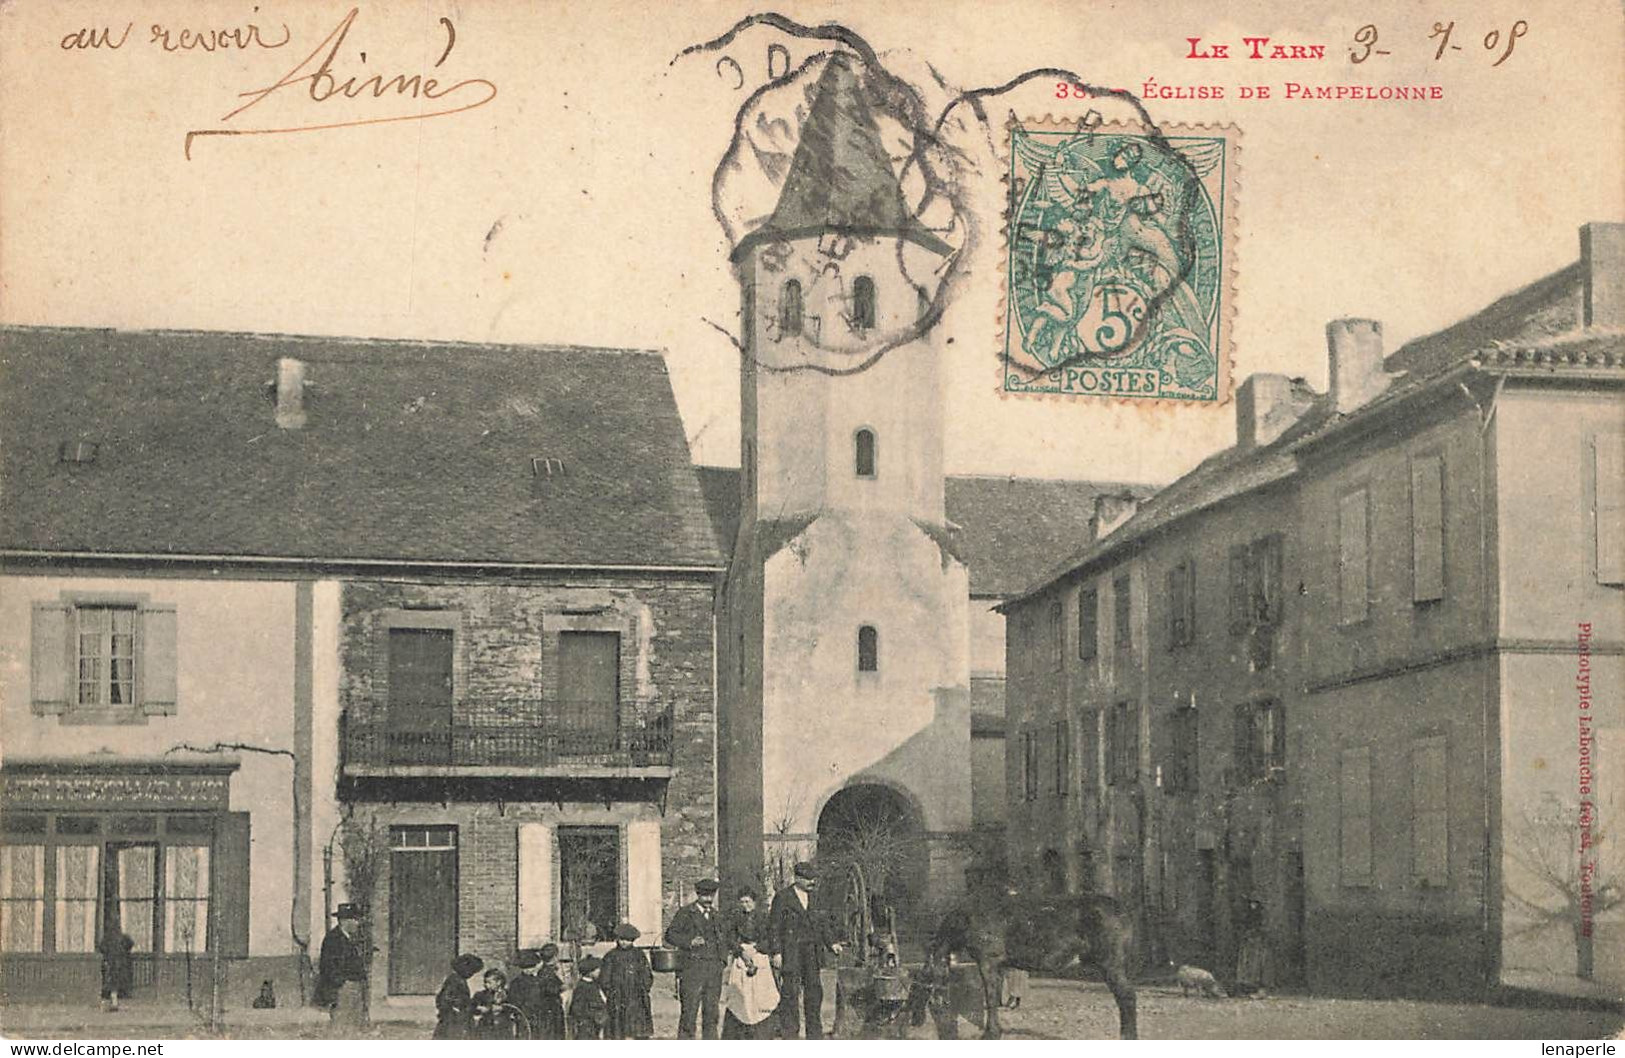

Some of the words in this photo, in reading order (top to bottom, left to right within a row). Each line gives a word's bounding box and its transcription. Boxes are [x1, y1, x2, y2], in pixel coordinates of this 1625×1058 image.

[60, 22, 133, 51] au
[150, 6, 291, 52] revoir
[1064, 367, 1156, 393] POSTES
